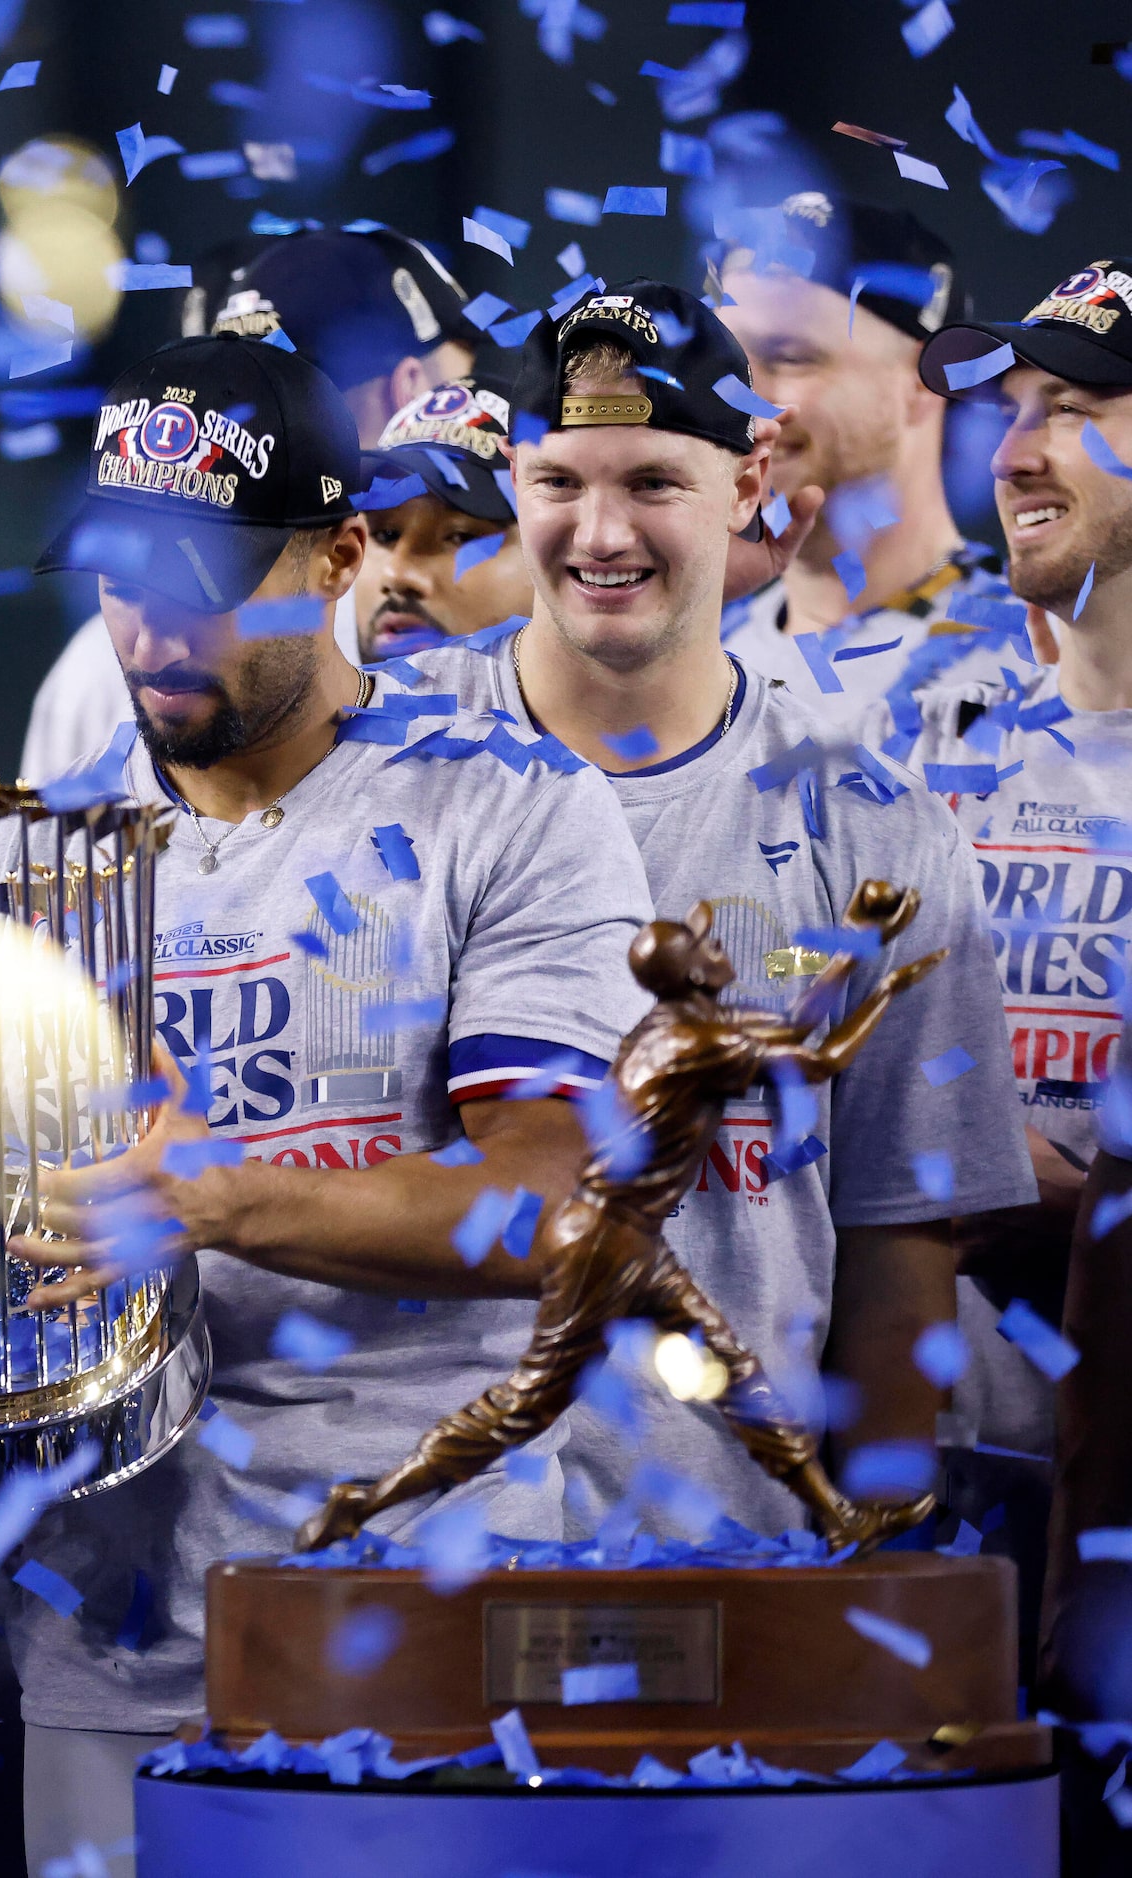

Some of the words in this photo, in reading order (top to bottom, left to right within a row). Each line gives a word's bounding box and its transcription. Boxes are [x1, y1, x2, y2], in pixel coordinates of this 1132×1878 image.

[557, 307, 660, 344] CHAMPS
[162, 385, 197, 404] 2023
[94, 398, 151, 452] WORLD
[155, 413, 186, 450] T
[198, 409, 276, 480] SERIES
[97, 450, 240, 508] CHAMPIONS
[1012, 817, 1045, 834] FALL
[976, 859, 1132, 924] ORLD
[164, 924, 203, 941] 2023
[174, 937, 256, 957] CLASSIC
